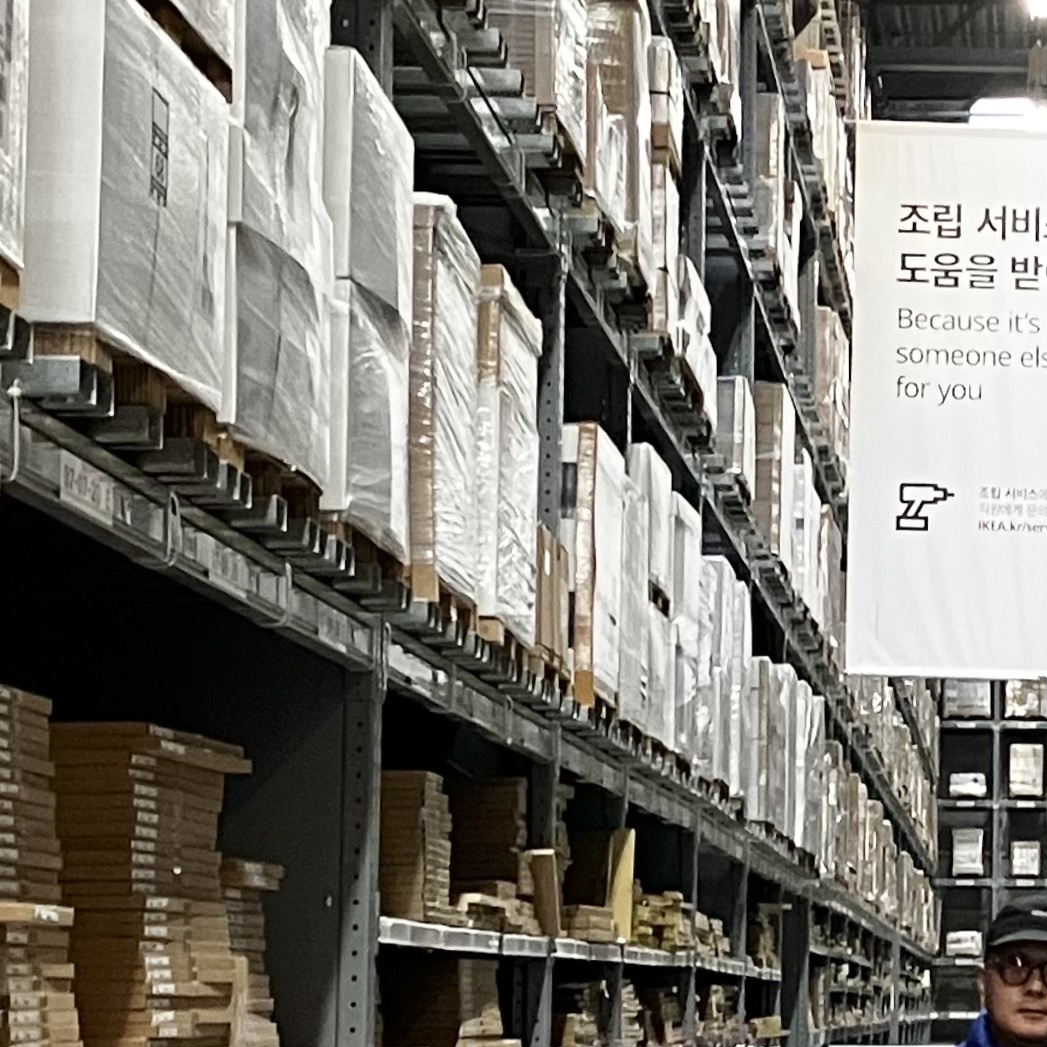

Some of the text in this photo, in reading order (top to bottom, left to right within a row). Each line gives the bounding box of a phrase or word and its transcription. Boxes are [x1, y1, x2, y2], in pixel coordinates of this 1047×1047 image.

[897, 203, 962, 239] 조립
[896, 252, 998, 289] 도움을
[898, 308, 999, 332] Because
[896, 346, 1012, 367] someone
[896, 375, 983, 407] for you
[979, 487, 1001, 499] 조립
